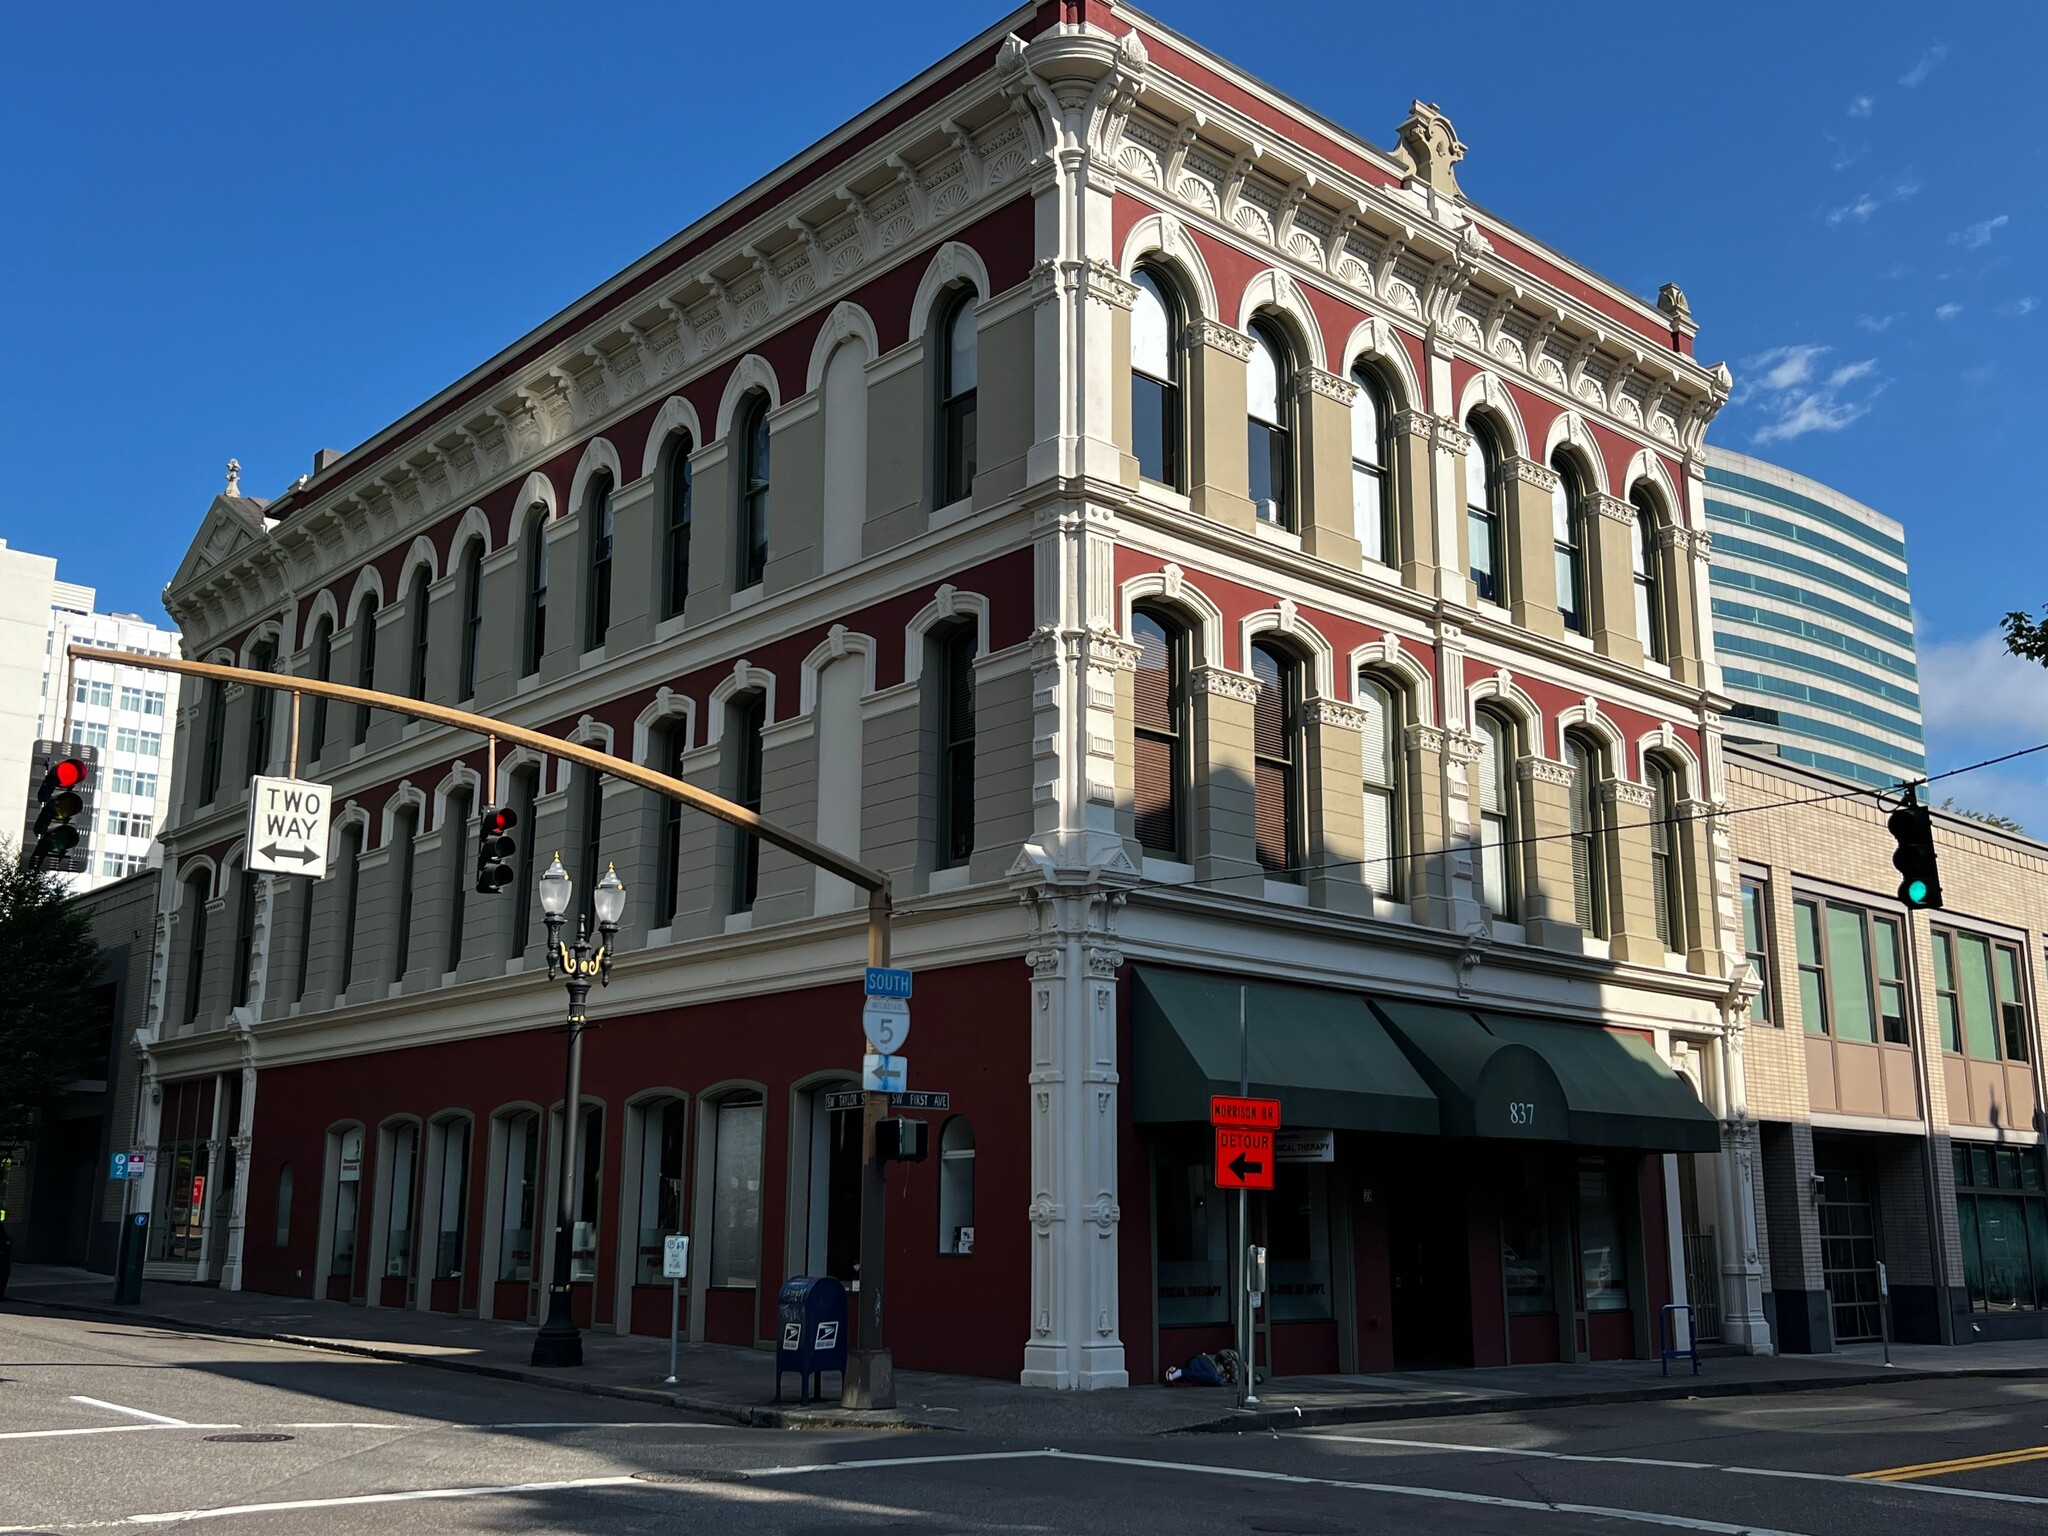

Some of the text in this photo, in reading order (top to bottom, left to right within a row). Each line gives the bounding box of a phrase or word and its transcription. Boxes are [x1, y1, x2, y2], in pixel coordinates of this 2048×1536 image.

[267, 788, 320, 815] TWO
[267, 814, 318, 840] WAY
[869, 973, 909, 992] SOUTH
[871, 1002, 902, 1011] INTERSTATE
[880, 1018, 893, 1044] 5
[827, 1096, 835, 1108] SW
[839, 1094, 857, 1107] TAYLOR
[891, 1093, 947, 1107] SW FIRST AVE
[1214, 1105, 1273, 1120] MORRISON BR
[1510, 1102, 1534, 1125] 837
[1221, 1133, 1269, 1149] DETOUR
[1297, 1142, 1329, 1151] THERAPY
[116, 1165, 123, 1175] 2
[1188, 1285, 1222, 1297] THERAPY
